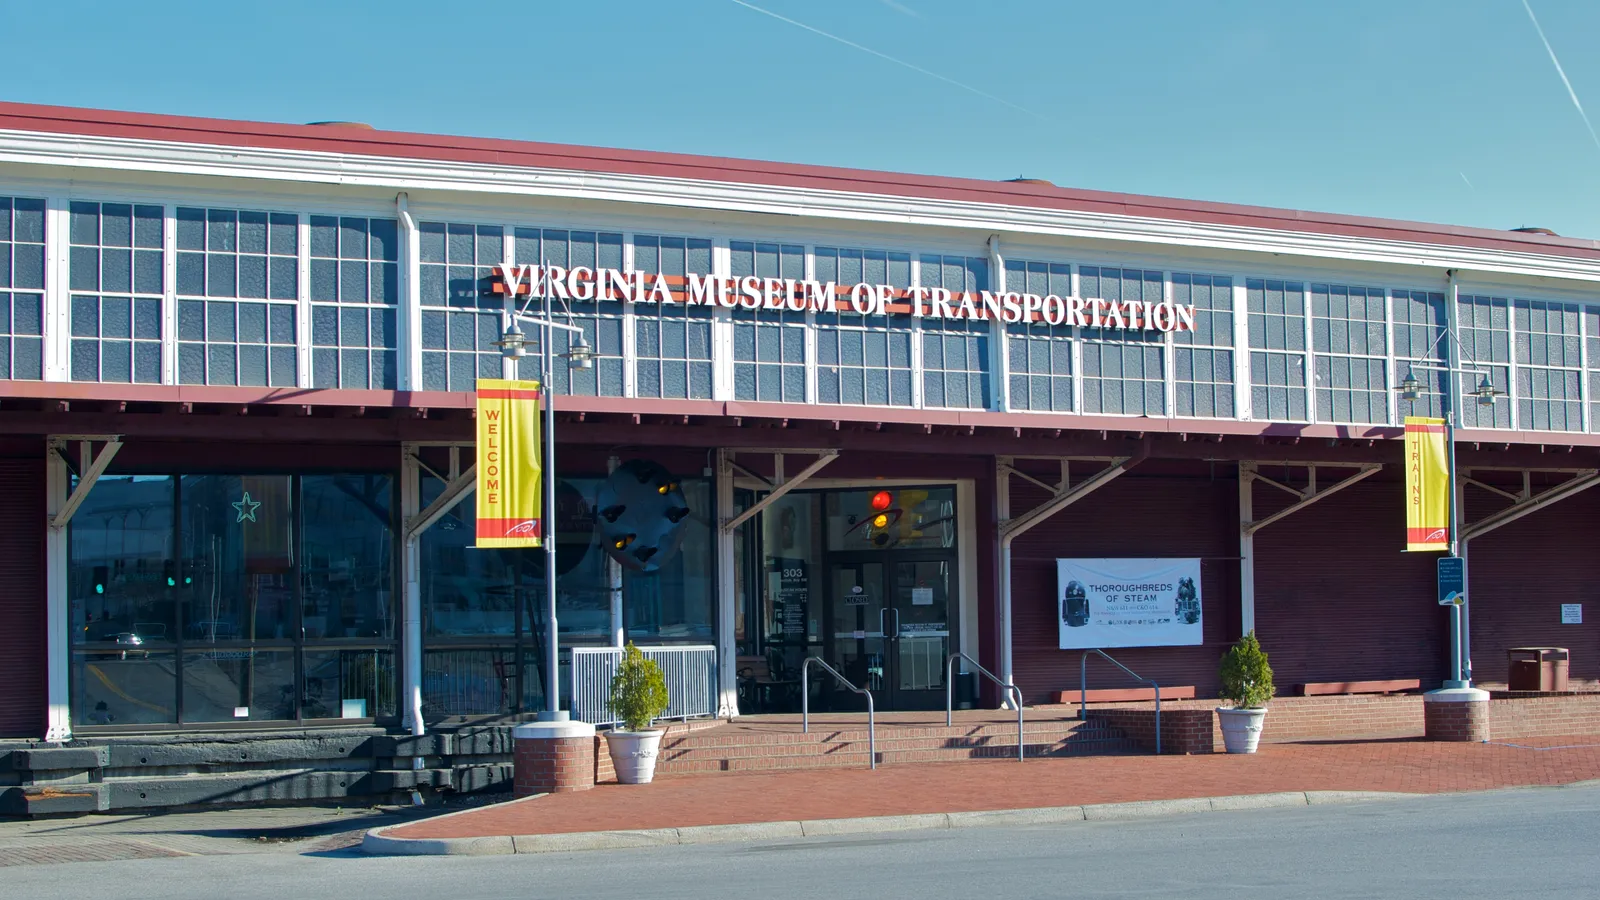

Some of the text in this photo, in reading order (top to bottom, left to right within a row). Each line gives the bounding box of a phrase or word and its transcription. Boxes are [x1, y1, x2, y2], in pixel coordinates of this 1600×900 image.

[498, 262, 1196, 334] VIRGINIA MUSEUM OF TRANSPORTATION
[485, 410, 500, 504] WELCOME
[1412, 441, 1420, 505] TRAINS
[783, 568, 803, 578] 303
[1089, 584, 1173, 592] THOROUGHBREDS
[1106, 594, 1157, 602] OF STEAM
